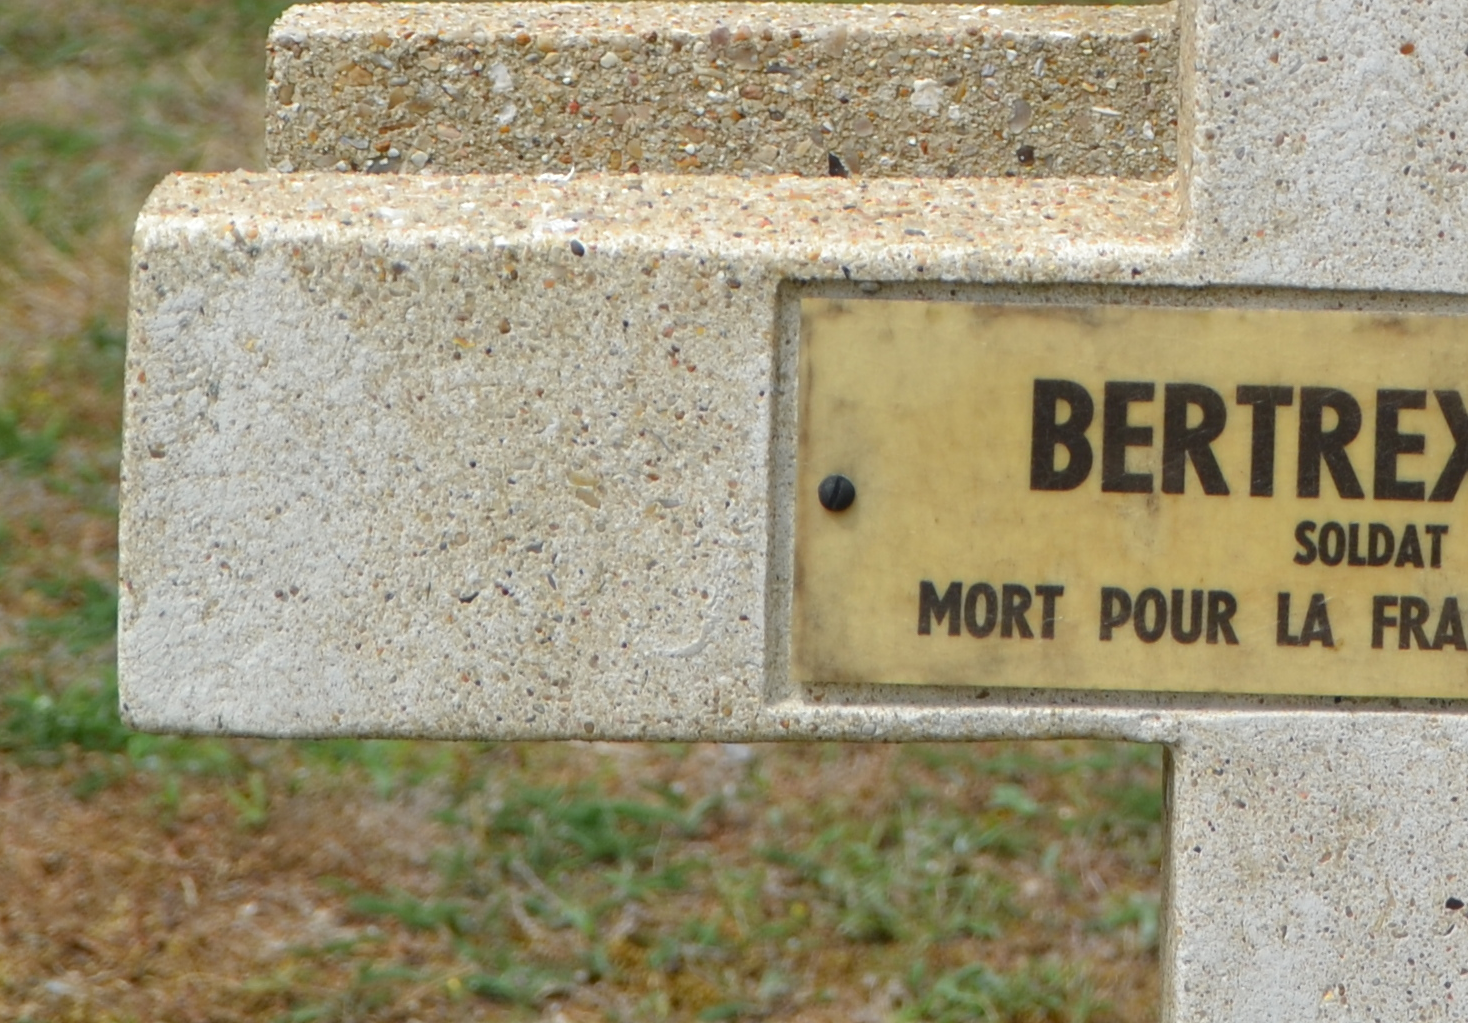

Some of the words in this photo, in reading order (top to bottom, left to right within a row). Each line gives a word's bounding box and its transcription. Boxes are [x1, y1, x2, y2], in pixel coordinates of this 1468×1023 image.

[1293, 519, 1450, 569] SOLDAT
[917, 579, 1065, 638] MORT
[1099, 586, 1239, 645] POUR
[1276, 591, 1335, 648] LA
